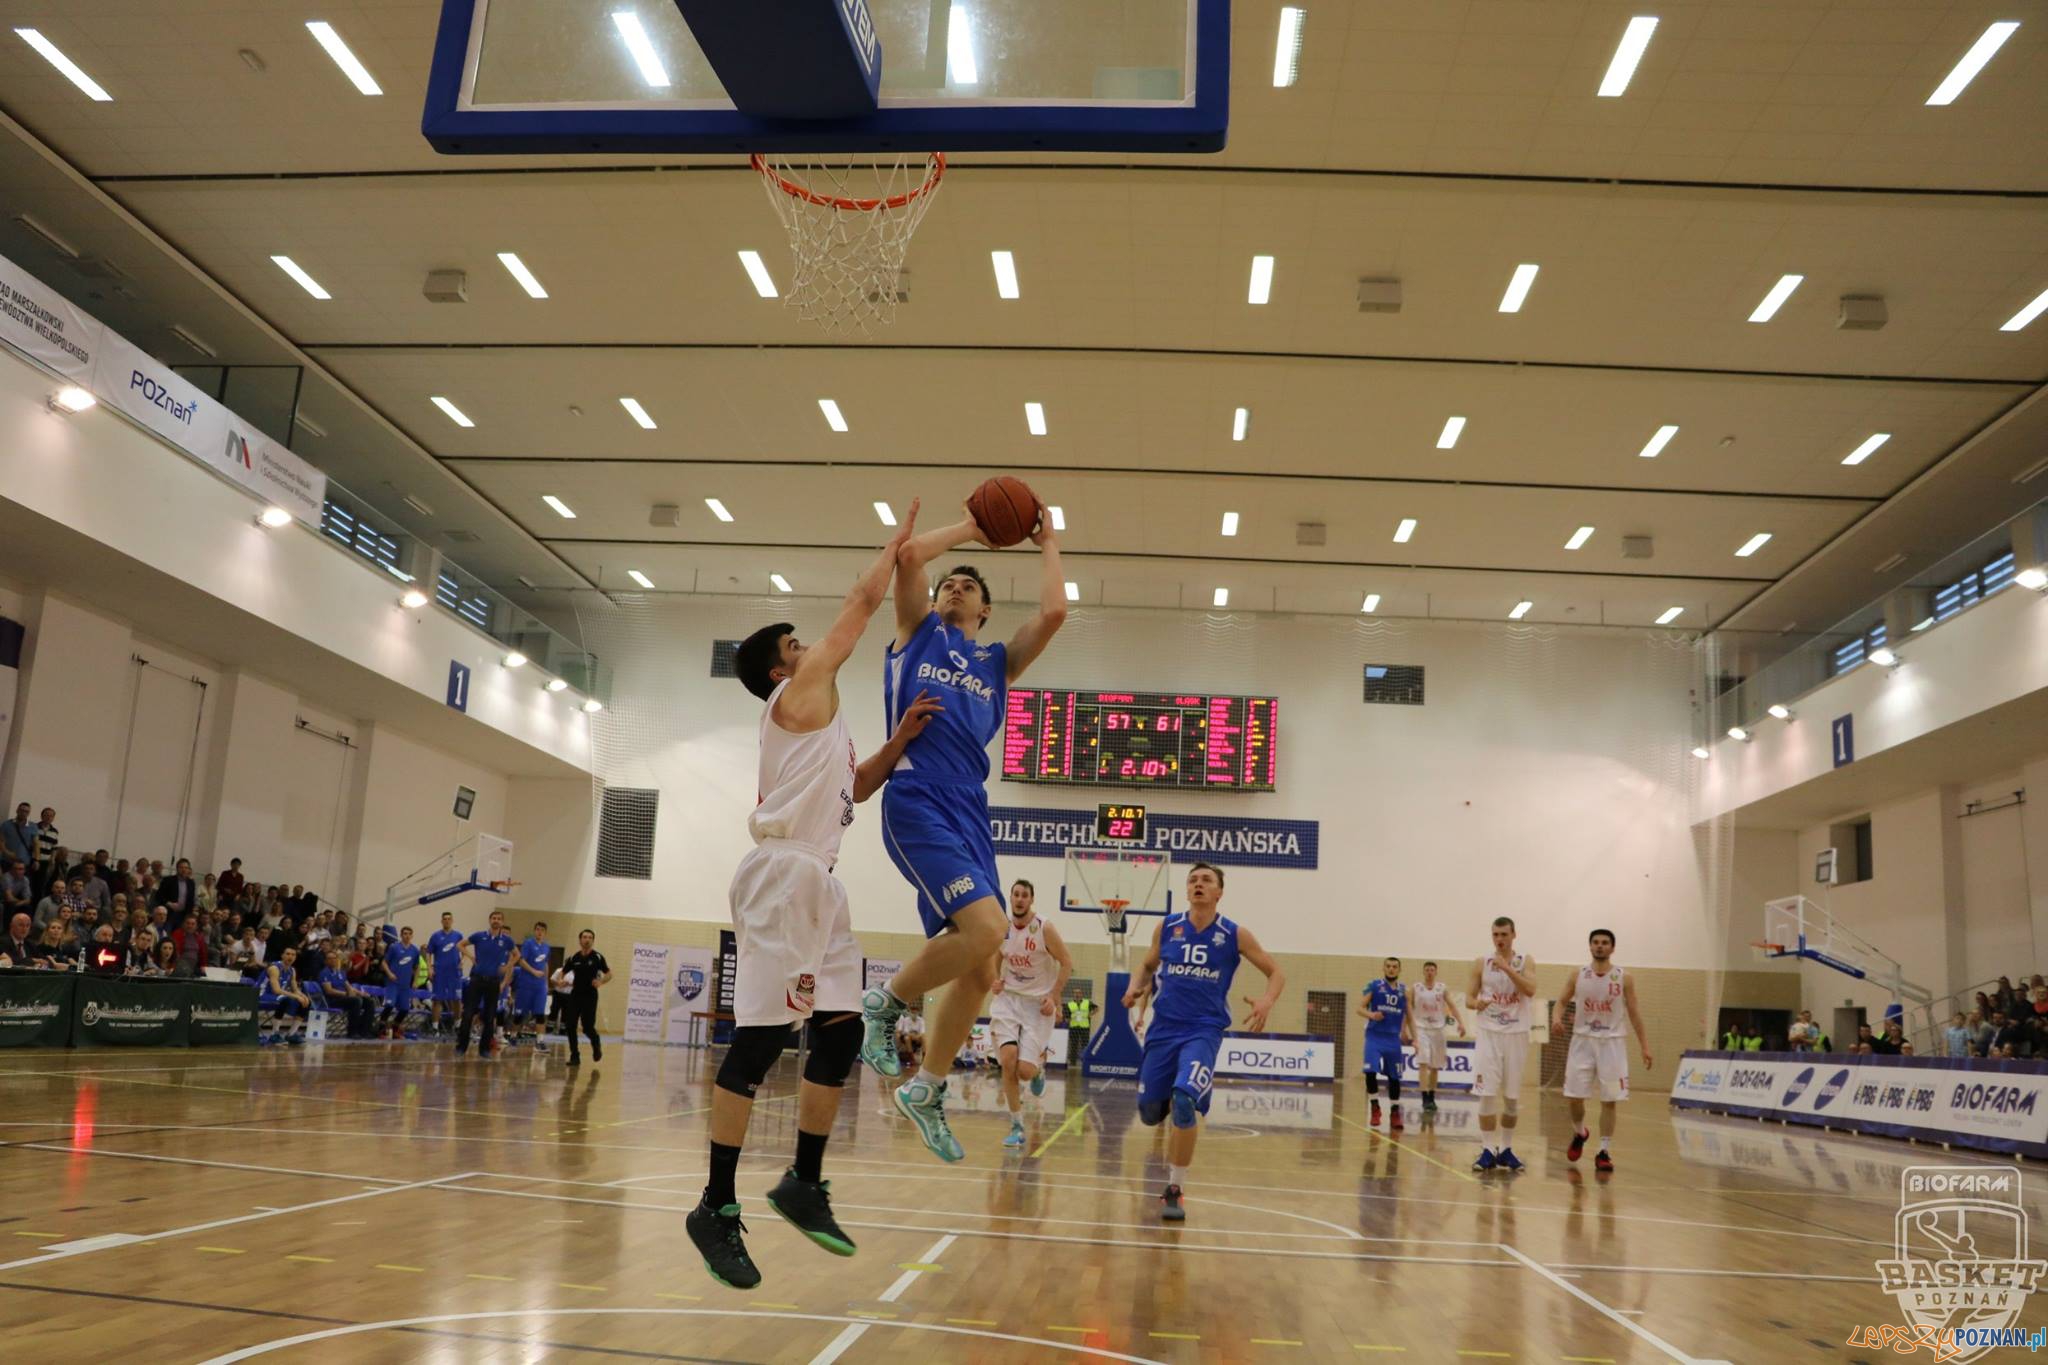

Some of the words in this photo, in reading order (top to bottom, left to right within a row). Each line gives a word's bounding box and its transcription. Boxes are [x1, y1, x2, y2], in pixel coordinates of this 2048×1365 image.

[35, 321, 89, 364] WIELKOPOLSKIEGO
[455, 669, 464, 706] 1
[917, 662, 994, 702] BIOFARM
[1107, 714, 1131, 730] 57
[1157, 716, 1180, 731] 61
[1836, 722, 1846, 761] 1
[1109, 820, 1133, 836] 22
[1155, 826, 1301, 855] POZNAŃSKA
[949, 876, 975, 898] PBG
[1025, 936, 1036, 952] 16
[1181, 943, 1208, 965] 16
[1385, 993, 1398, 1006] 10
[1608, 983, 1621, 997] 13
[1189, 1060, 1211, 1090] 16
[1731, 1069, 1775, 1091] BIOFARM
[1951, 1082, 2038, 1116] BIOFARM
